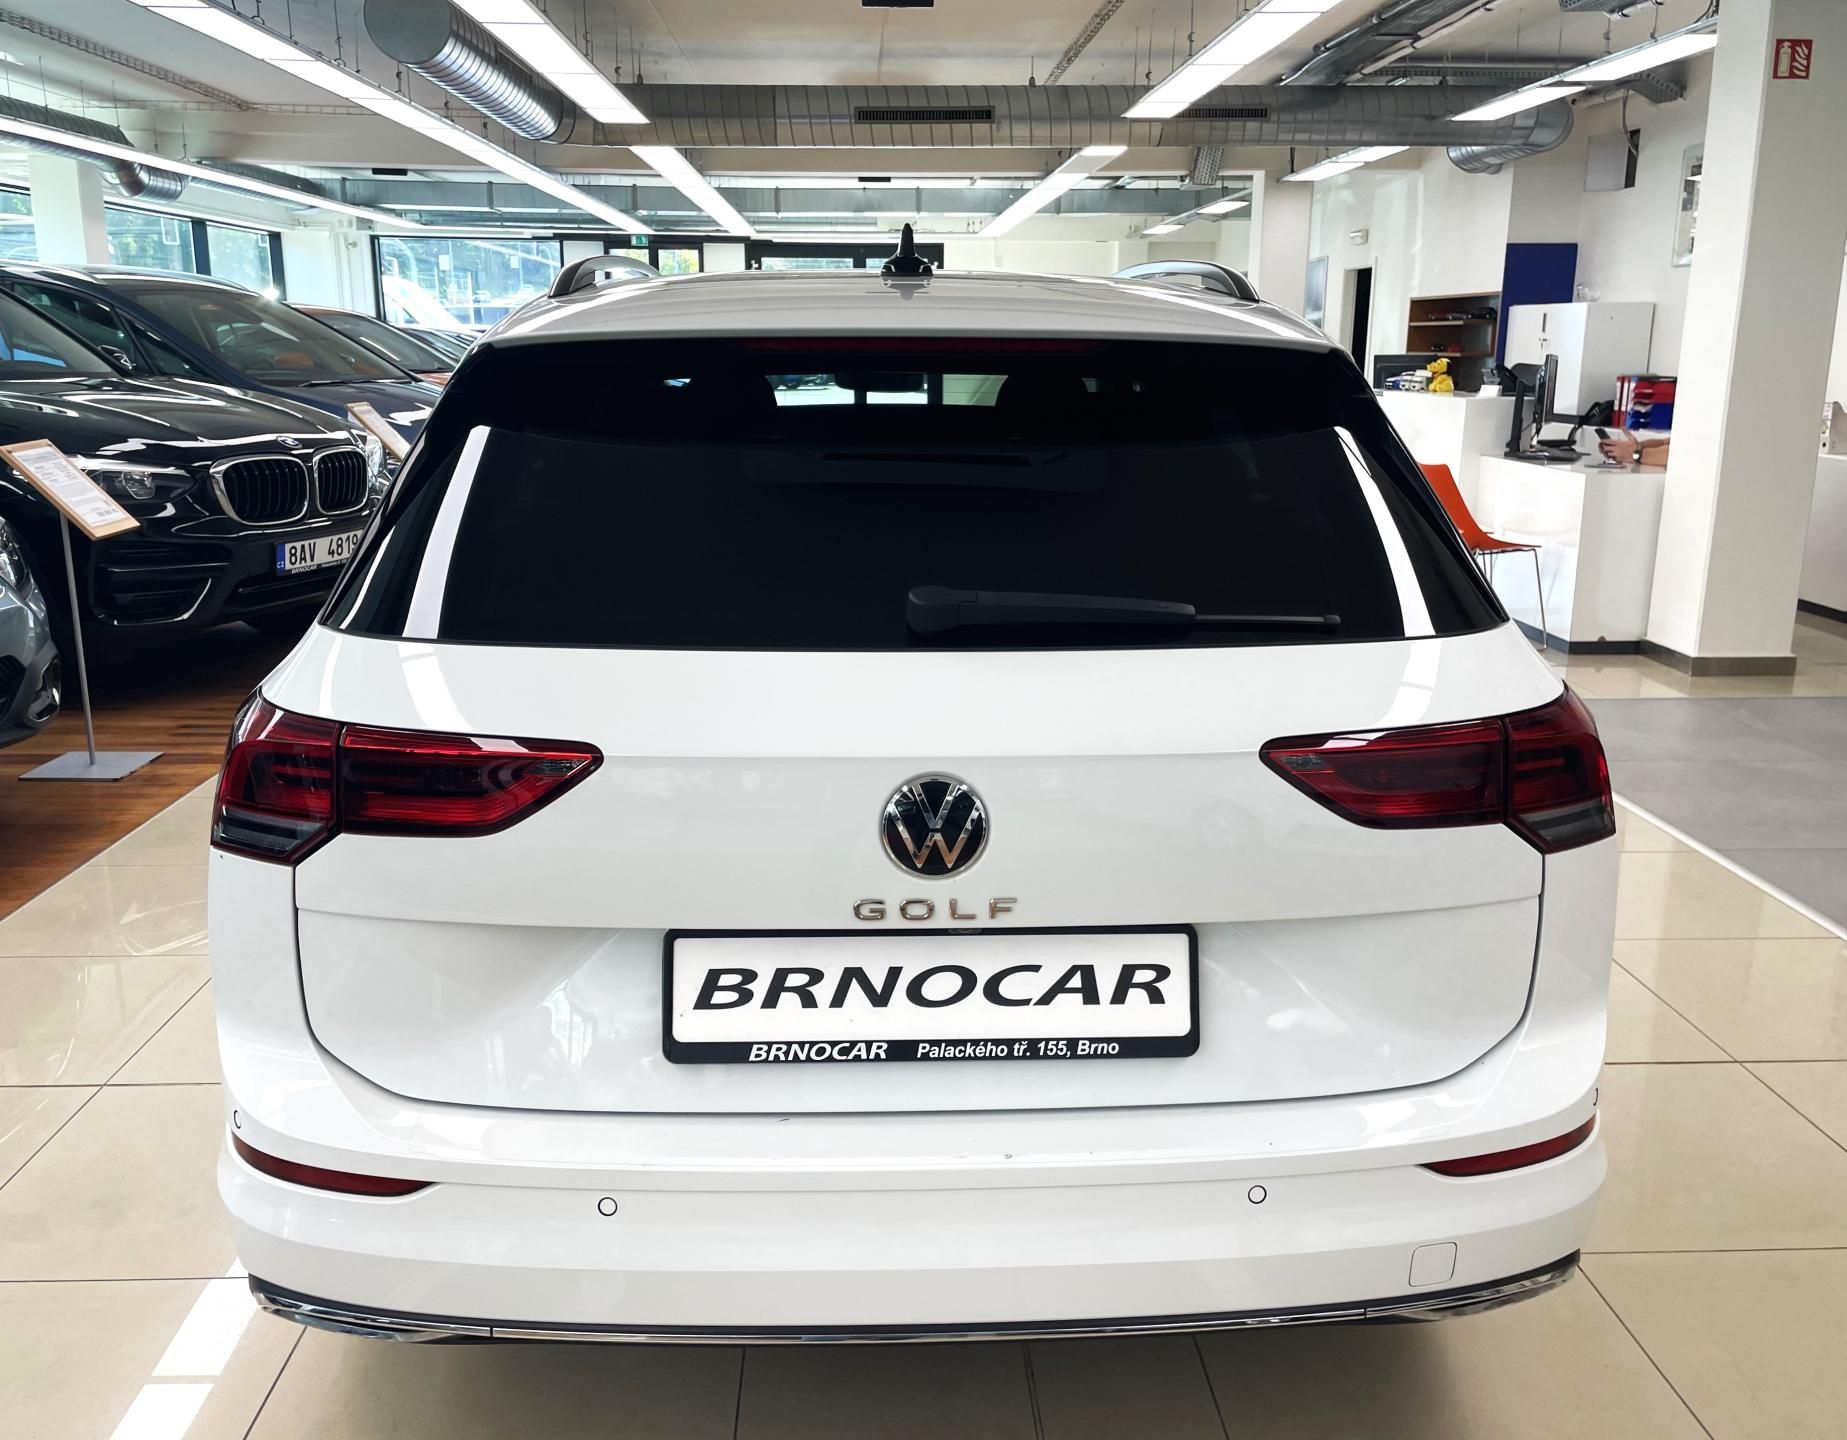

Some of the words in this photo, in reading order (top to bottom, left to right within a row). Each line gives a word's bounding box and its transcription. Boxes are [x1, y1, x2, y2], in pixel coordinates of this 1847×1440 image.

[289, 542, 316, 566] 8AV
[853, 898, 1018, 920] GOLF
[692, 963, 1172, 1010] BRNOCAR
[749, 1042, 888, 1061] BRNOCAR
[917, 1041, 1008, 1058] Palackého
[1013, 1041, 1031, 1057] tř.
[1037, 1040, 1071, 1058] 155,
[1077, 1040, 1120, 1056] Brno
